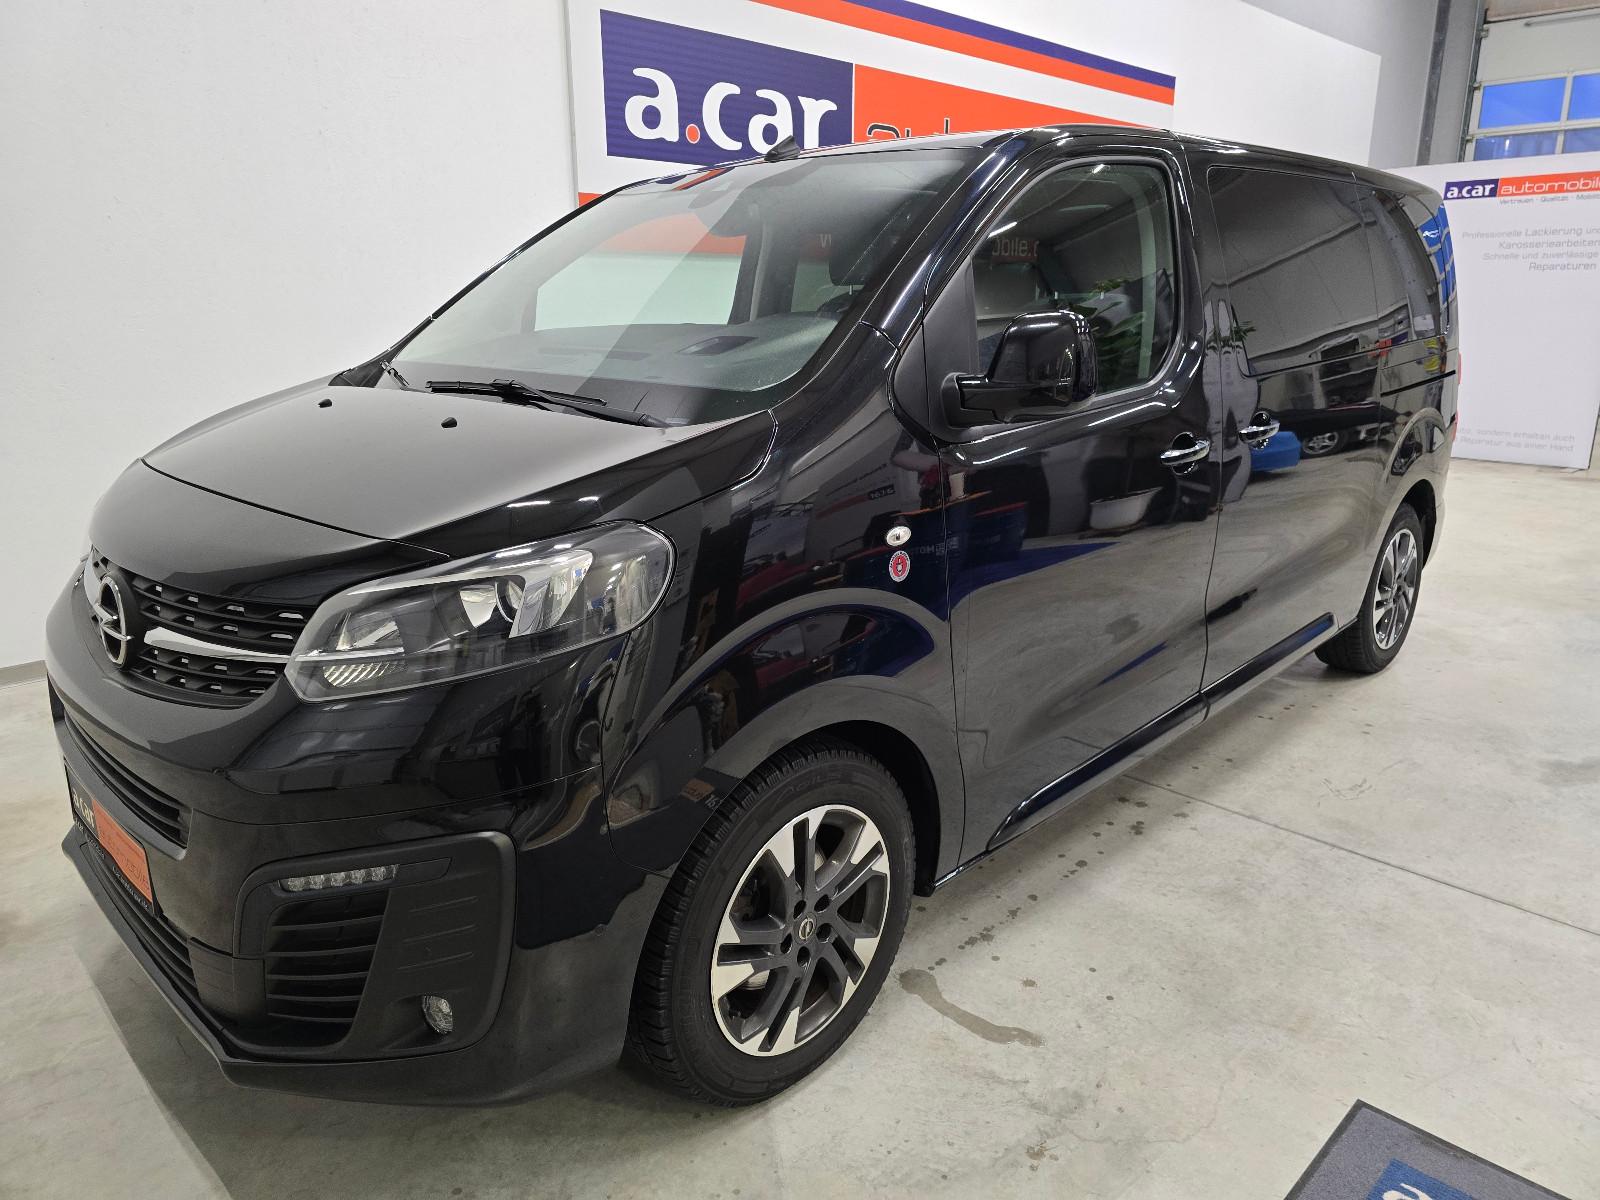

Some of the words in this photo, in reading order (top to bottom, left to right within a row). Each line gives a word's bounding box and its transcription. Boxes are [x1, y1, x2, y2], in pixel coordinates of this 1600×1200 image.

[624, 67, 838, 154] a.car
[1447, 184, 1495, 199] a.car
[1501, 178, 1600, 194] automobil
[1462, 230, 1522, 239] Professionelle
[1525, 226, 1583, 238] Lackierung
[1482, 251, 1520, 261] Schnelle
[1522, 250, 1538, 260] und
[1528, 262, 1597, 273] Reparaturen
